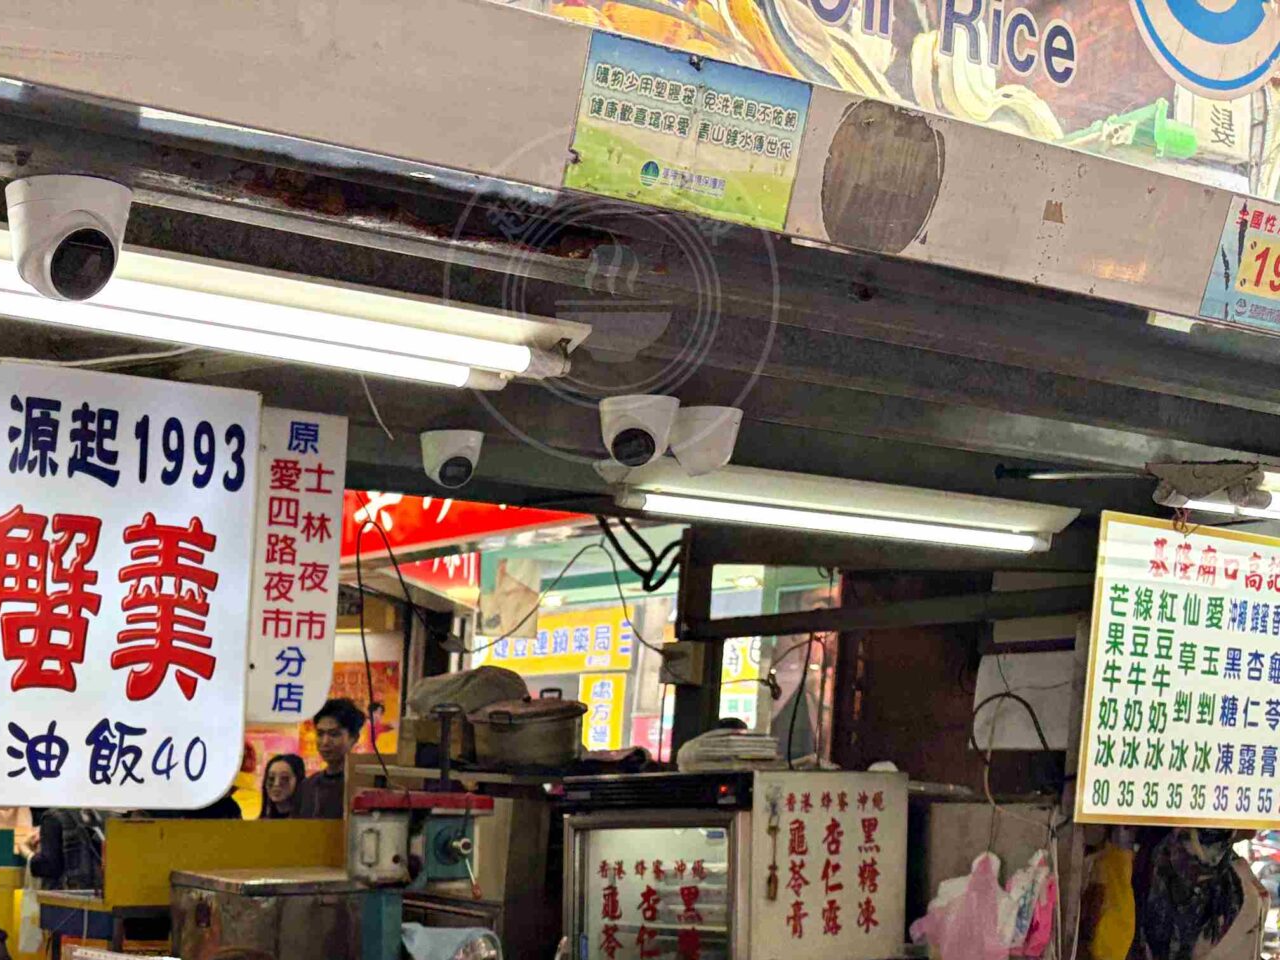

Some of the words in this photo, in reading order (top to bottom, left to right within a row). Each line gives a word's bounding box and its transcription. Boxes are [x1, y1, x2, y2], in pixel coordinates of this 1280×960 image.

[941, 0, 1076, 85] Rice
[596, 64, 695, 105] 購物少用塑膠袋
[698, 121, 792, 159] 青山綠水傳世代
[7, 393, 247, 493] 源起1993
[261, 459, 301, 639] 愛四路夜市
[296, 461, 335, 641] 士林夜市
[271, 647, 307, 714] 分店
[1094, 584, 1129, 768] 芒果牛奶冰
[1119, 586, 1154, 769] 綠豆牛奶冰
[1144, 589, 1178, 771] 紅豆牛奶冰
[1092, 779, 1110, 806] 80
[1117, 781, 1135, 807] 35
[1142, 782, 1159, 808] 35
[1166, 783, 1183, 809] 35
[1190, 784, 1206, 810] 35
[1213, 785, 1229, 812] 35
[1236, 786, 1251, 813] 35
[1257, 787, 1273, 814] 55
[821, 817, 844, 936] 杏仁露
